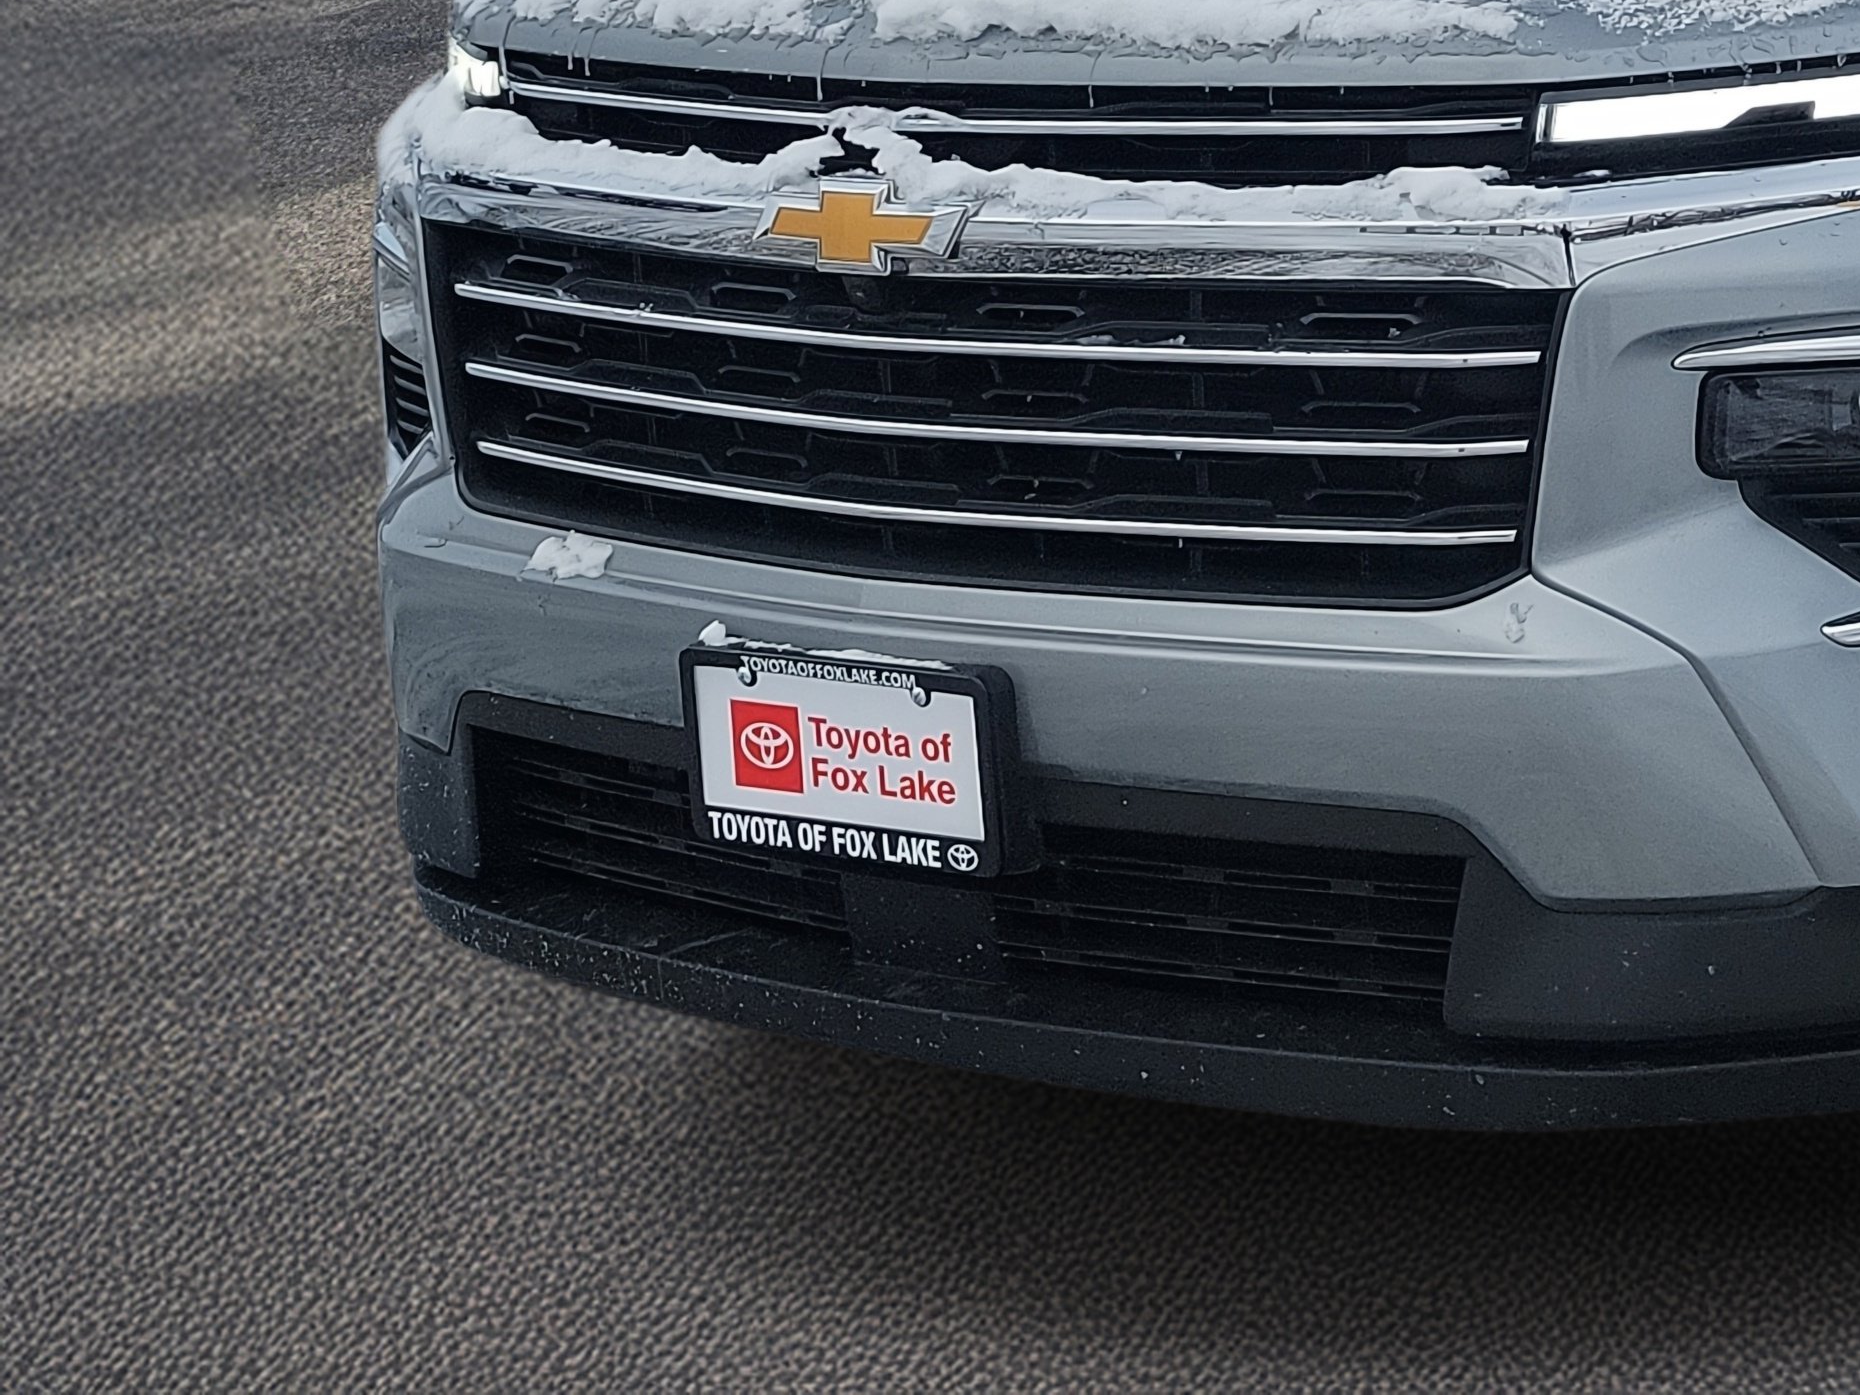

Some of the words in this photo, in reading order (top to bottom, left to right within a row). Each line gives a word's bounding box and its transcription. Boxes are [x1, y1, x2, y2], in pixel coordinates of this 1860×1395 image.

[740, 655, 916, 689] TOYOTAOFFOXLAKE.COM
[808, 716, 911, 759] Toyota
[920, 733, 952, 763] of
[811, 757, 869, 794] Fox
[878, 765, 956, 805] Lake
[708, 811, 793, 848] TOYOTA
[797, 823, 827, 853] OF
[832, 827, 877, 860] FOX
[882, 833, 943, 868] LAKE
